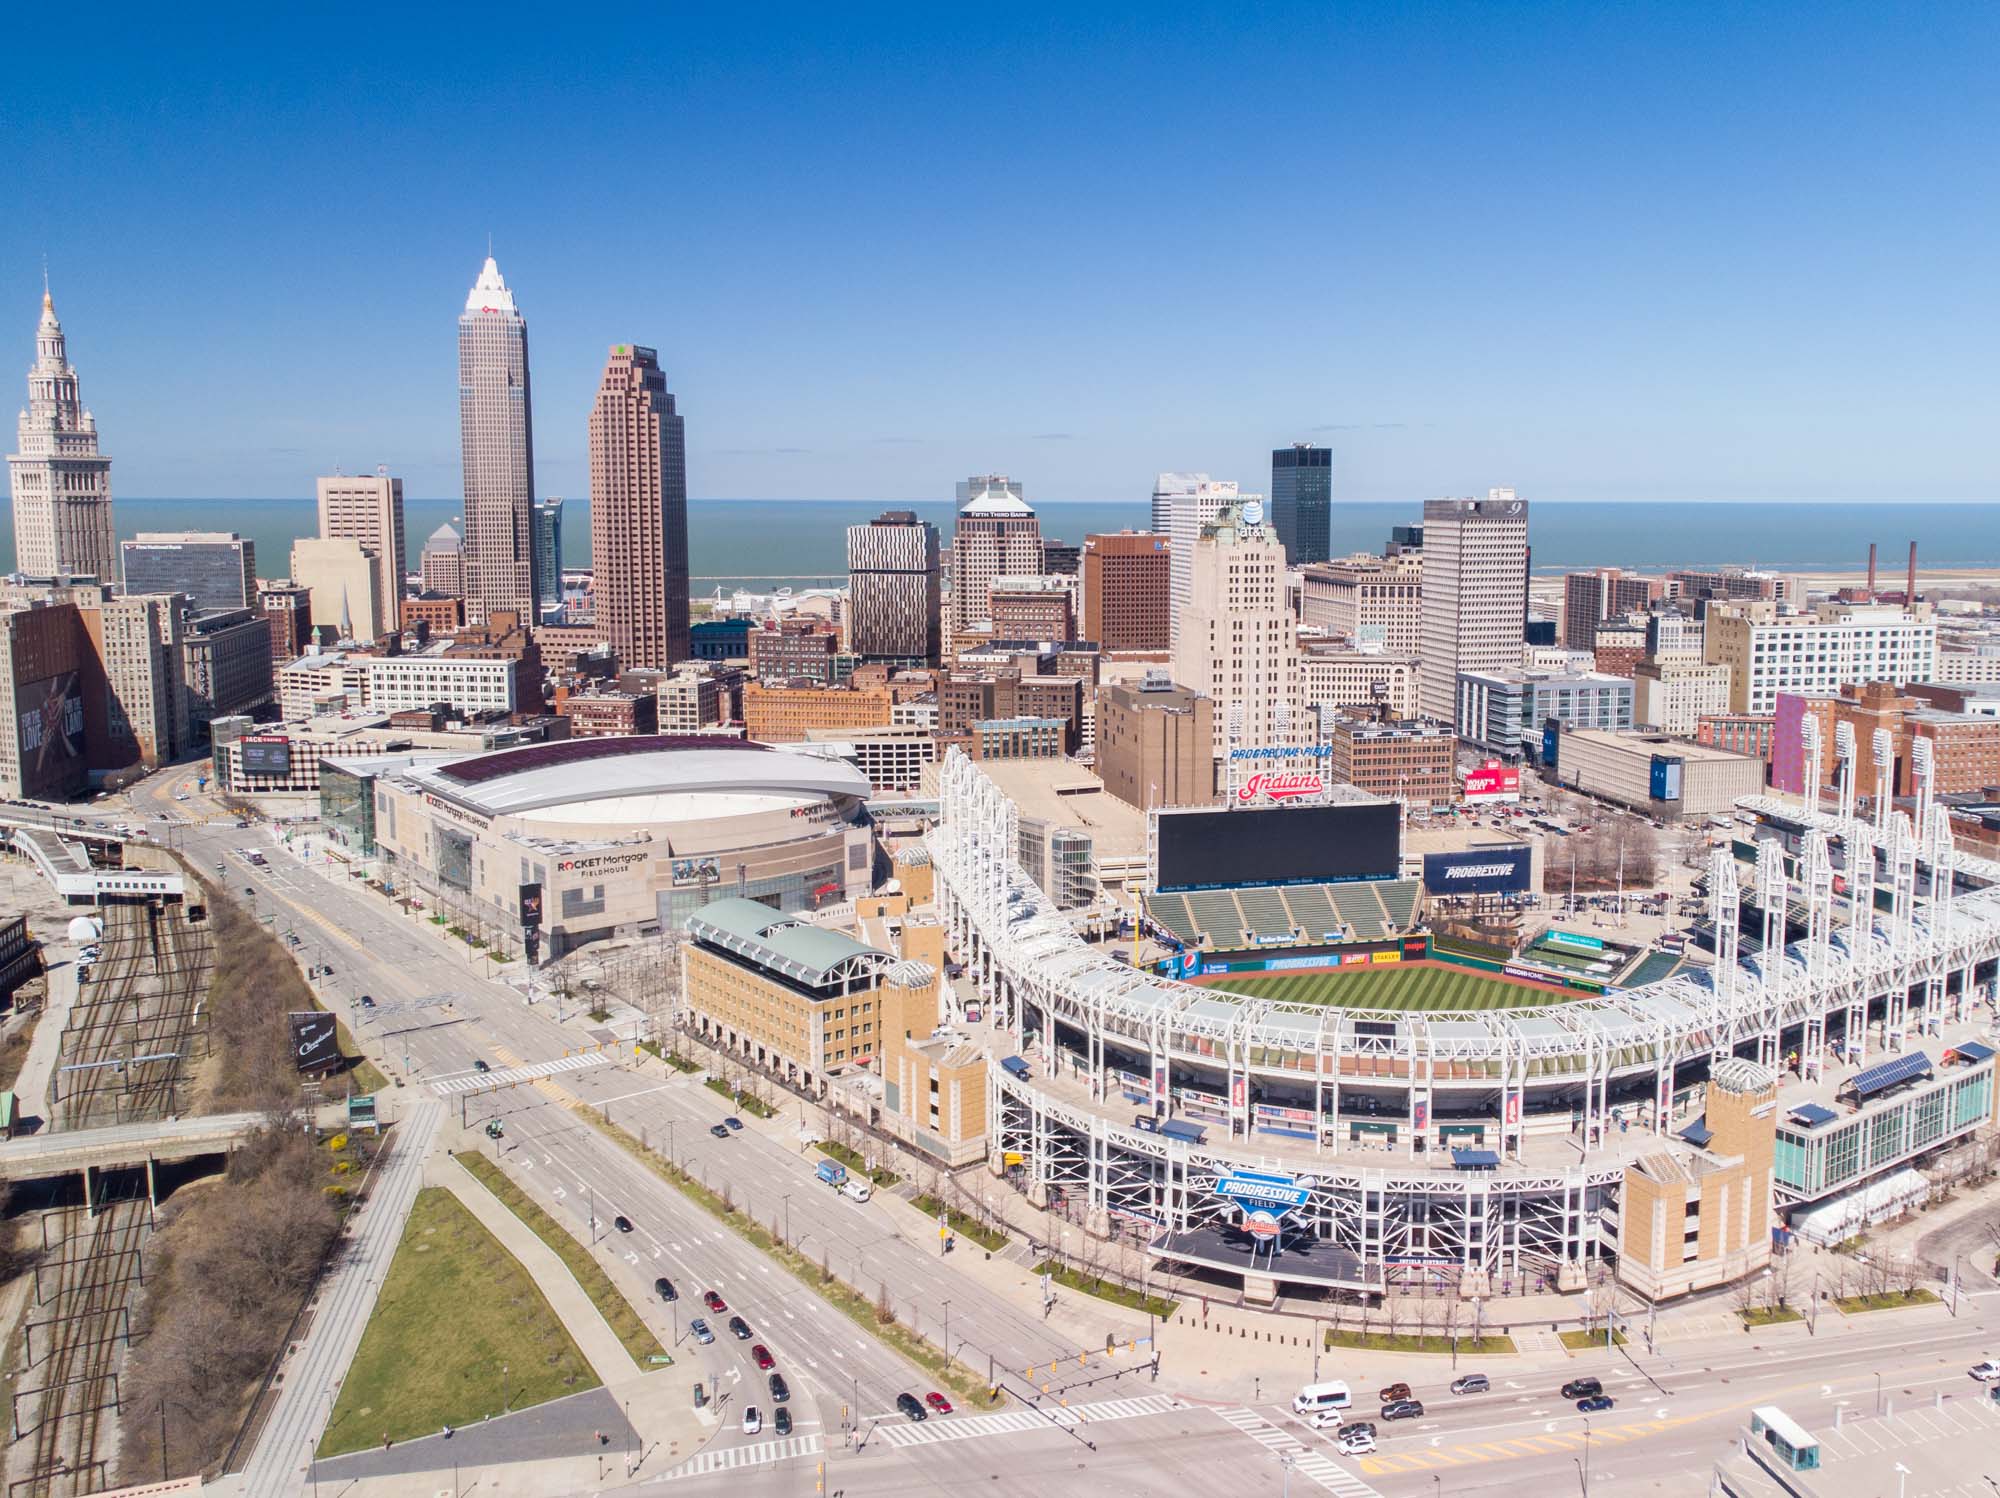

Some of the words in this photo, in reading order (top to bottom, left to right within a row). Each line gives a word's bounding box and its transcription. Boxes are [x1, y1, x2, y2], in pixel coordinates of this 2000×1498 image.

[1507, 501, 1522, 516] 9
[1240, 527, 1265, 537] at&t
[65, 710, 83, 736] LAND
[22, 723, 42, 751] LOVE
[1230, 746, 1300, 760] PROGRESSIVE
[1303, 744, 1333, 757] FIELD
[1238, 772, 1324, 801] Indians
[790, 803, 822, 818] ROCKET
[557, 857, 602, 872] ROCKET
[603, 852, 648, 865] Mortgage
[1444, 862, 1516, 879] PROGRESSIVE
[1222, 1181, 1302, 1203] PROGRESSIVE
[1248, 1198, 1276, 1209] FIELD
